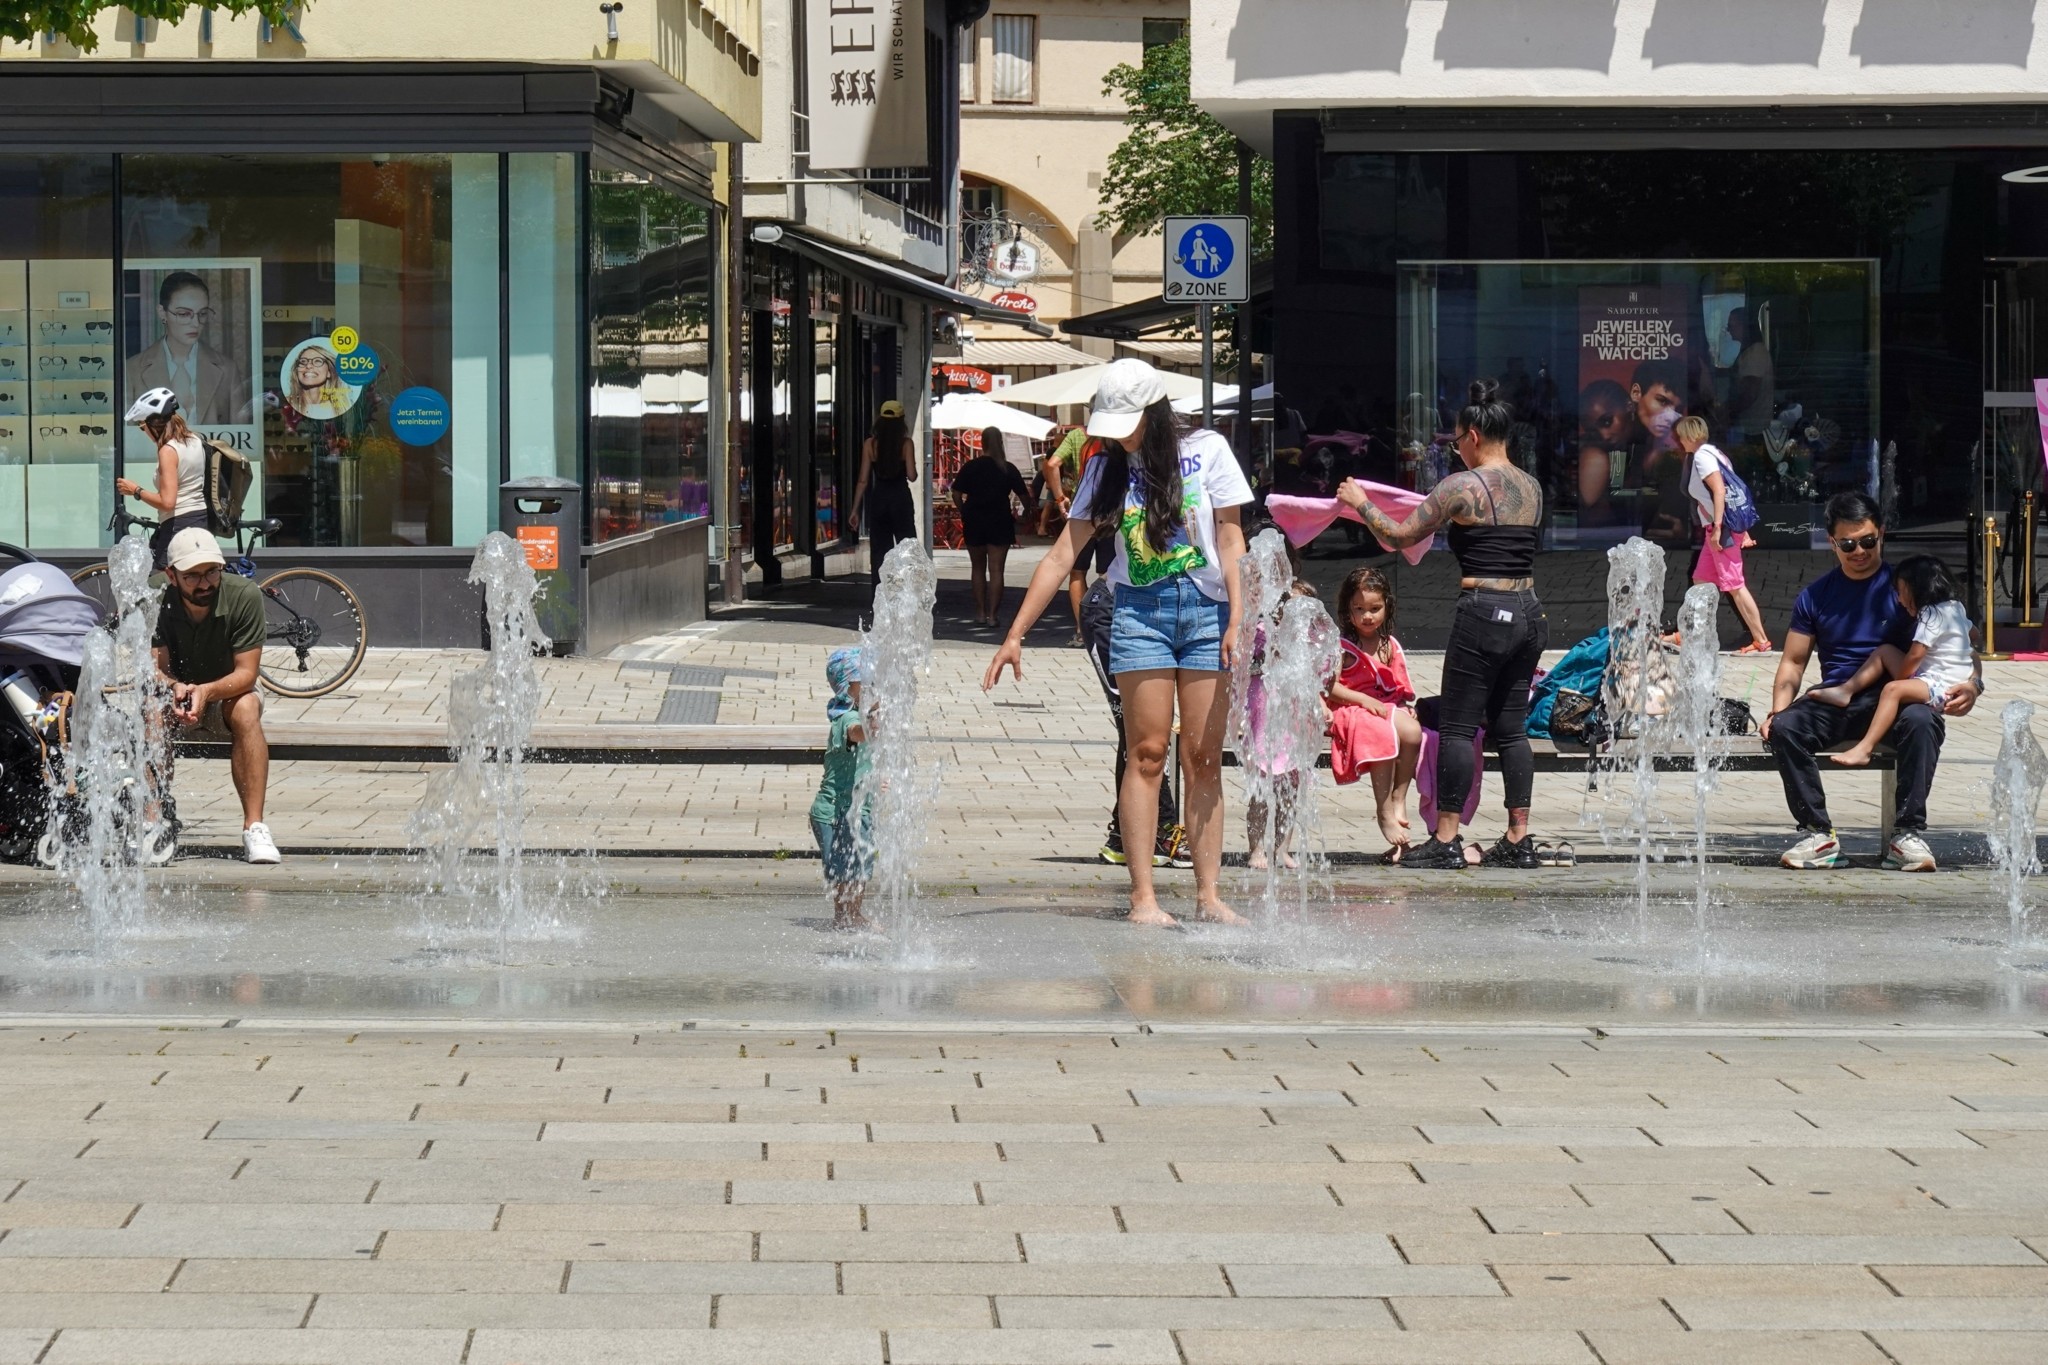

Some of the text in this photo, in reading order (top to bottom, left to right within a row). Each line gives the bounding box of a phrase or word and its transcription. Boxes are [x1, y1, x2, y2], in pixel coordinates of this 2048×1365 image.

[893, 53, 904, 80] WIR
[1185, 282, 1227, 296] ZONE
[994, 294, 1036, 310] Arche
[1607, 306, 1660, 315] SABOTEUR
[1593, 320, 1673, 334] JEWELLERY
[337, 335, 352, 346] 50
[1582, 333, 1684, 347] FINE PIERCING
[1597, 346, 1669, 360] WATCHES
[339, 356, 375, 370] 50%
